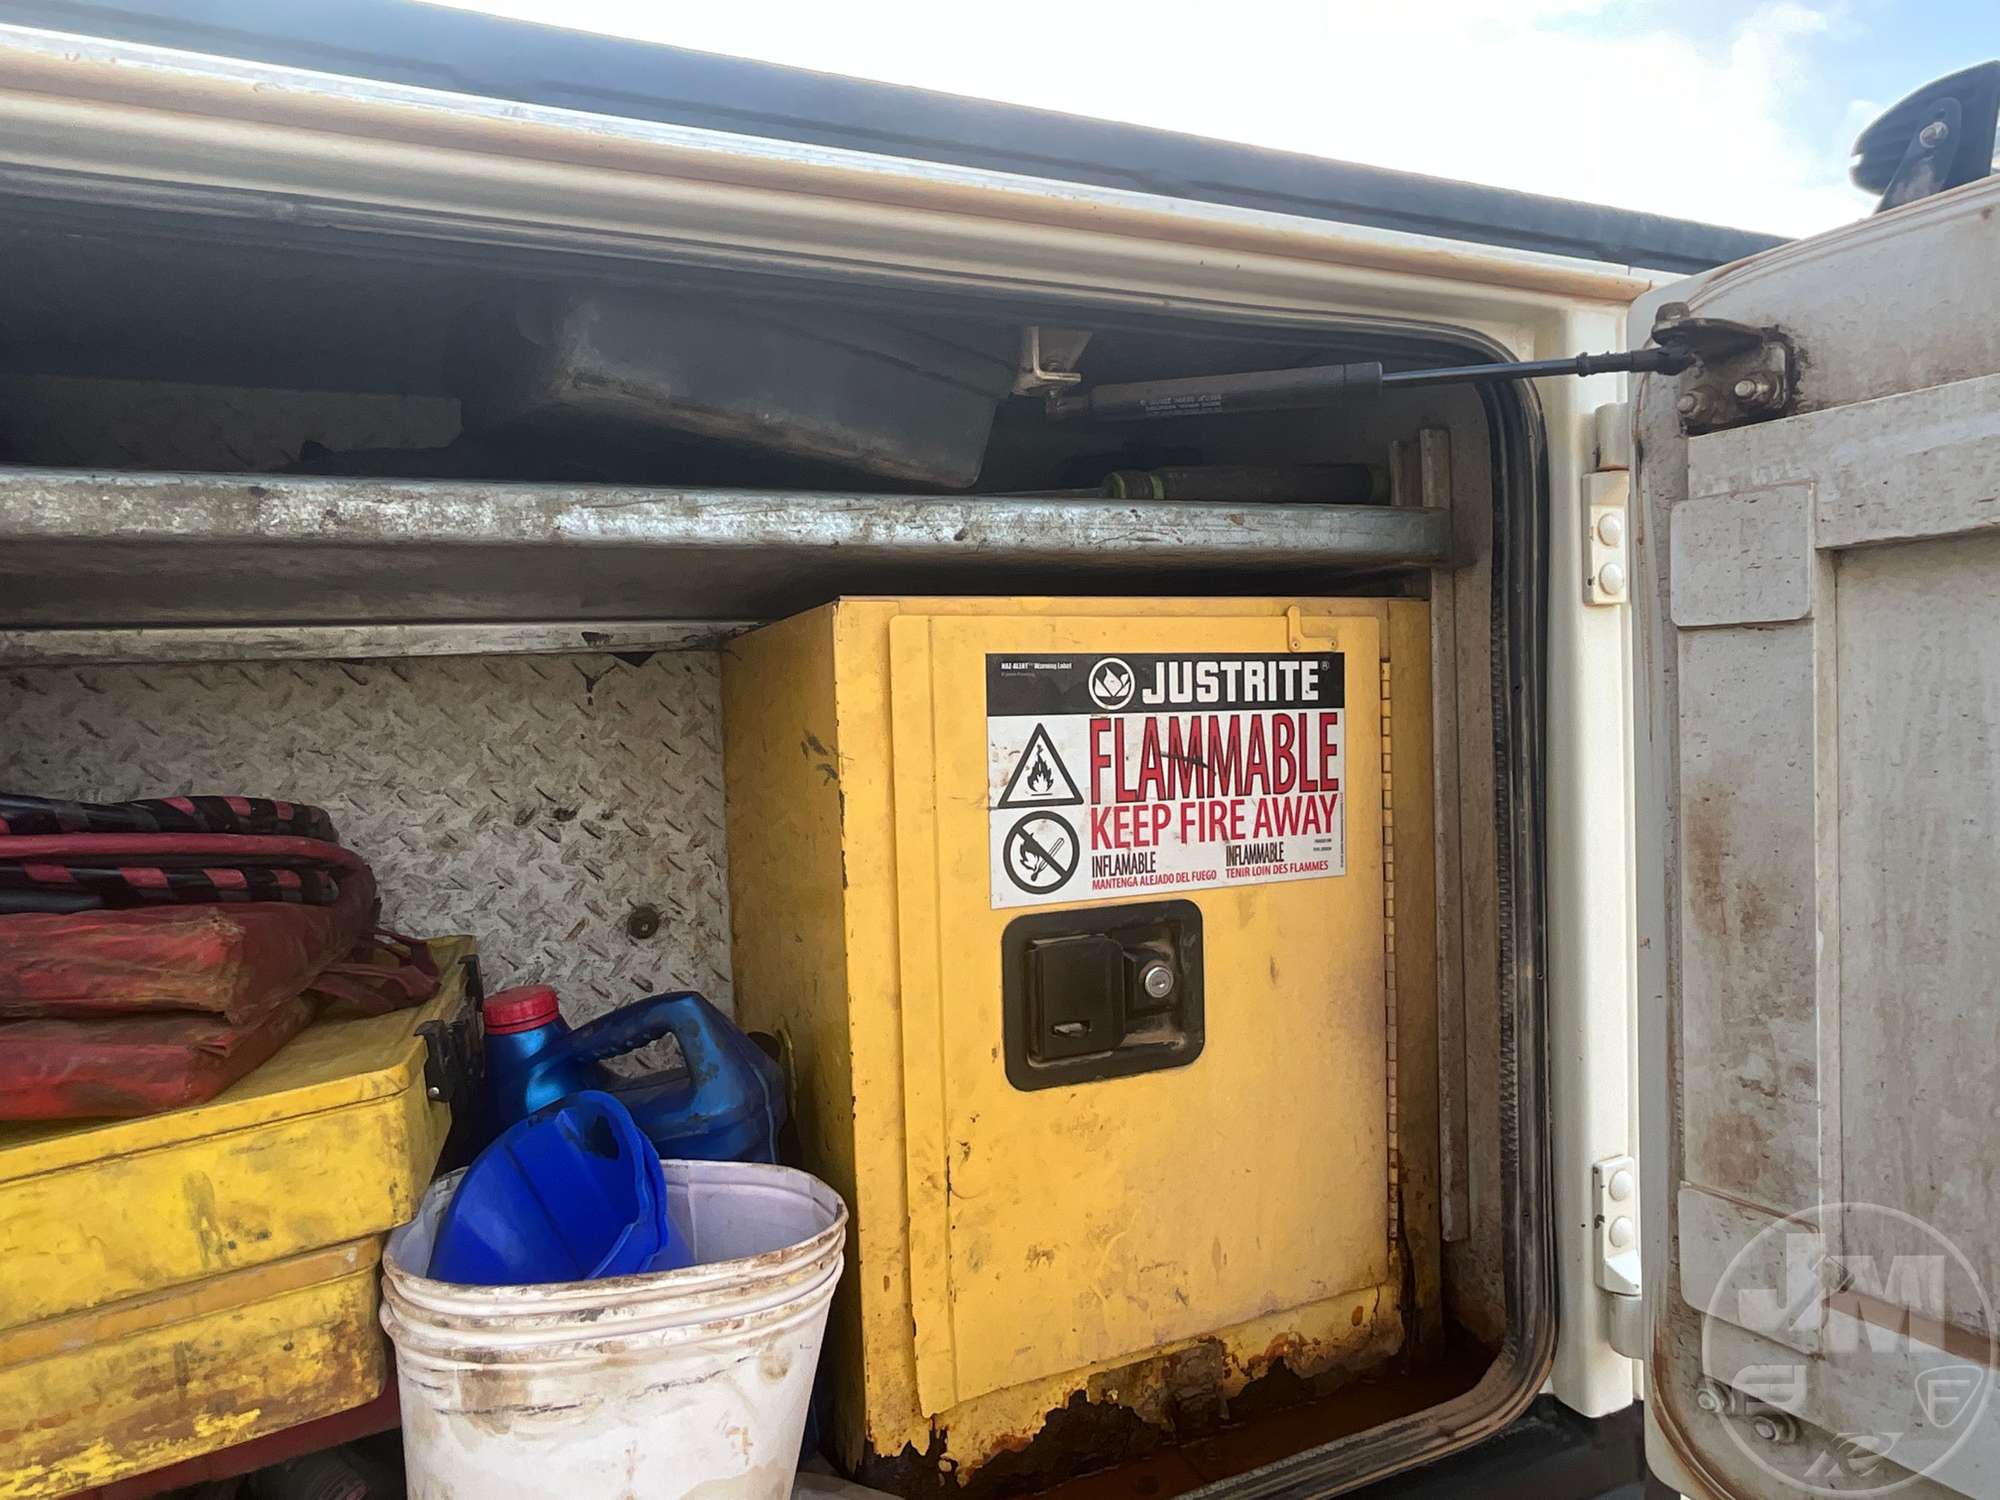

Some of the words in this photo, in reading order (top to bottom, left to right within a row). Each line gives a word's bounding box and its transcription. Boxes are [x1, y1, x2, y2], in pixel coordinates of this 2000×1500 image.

[1057, 662, 1072, 670] Label
[1089, 712, 1339, 805] FLAMMABLE
[1090, 803, 1171, 850] KEEP
[1181, 799, 1246, 844] FIRE
[1253, 793, 1338, 839] AWAY
[1092, 851, 1156, 878] INFLAMABLE
[1226, 841, 1284, 867] INFLAMMABLE
[1092, 877, 1139, 890] MANTENGA
[1140, 873, 1175, 887] ALEJADO
[1176, 872, 1190, 883] DEL
[1191, 869, 1217, 882] FUEGO
[1225, 867, 1250, 879] TENIR
[1252, 865, 1271, 877] LOIN
[1273, 863, 1288, 875] DES
[1290, 860, 1329, 873] FLAMMES
